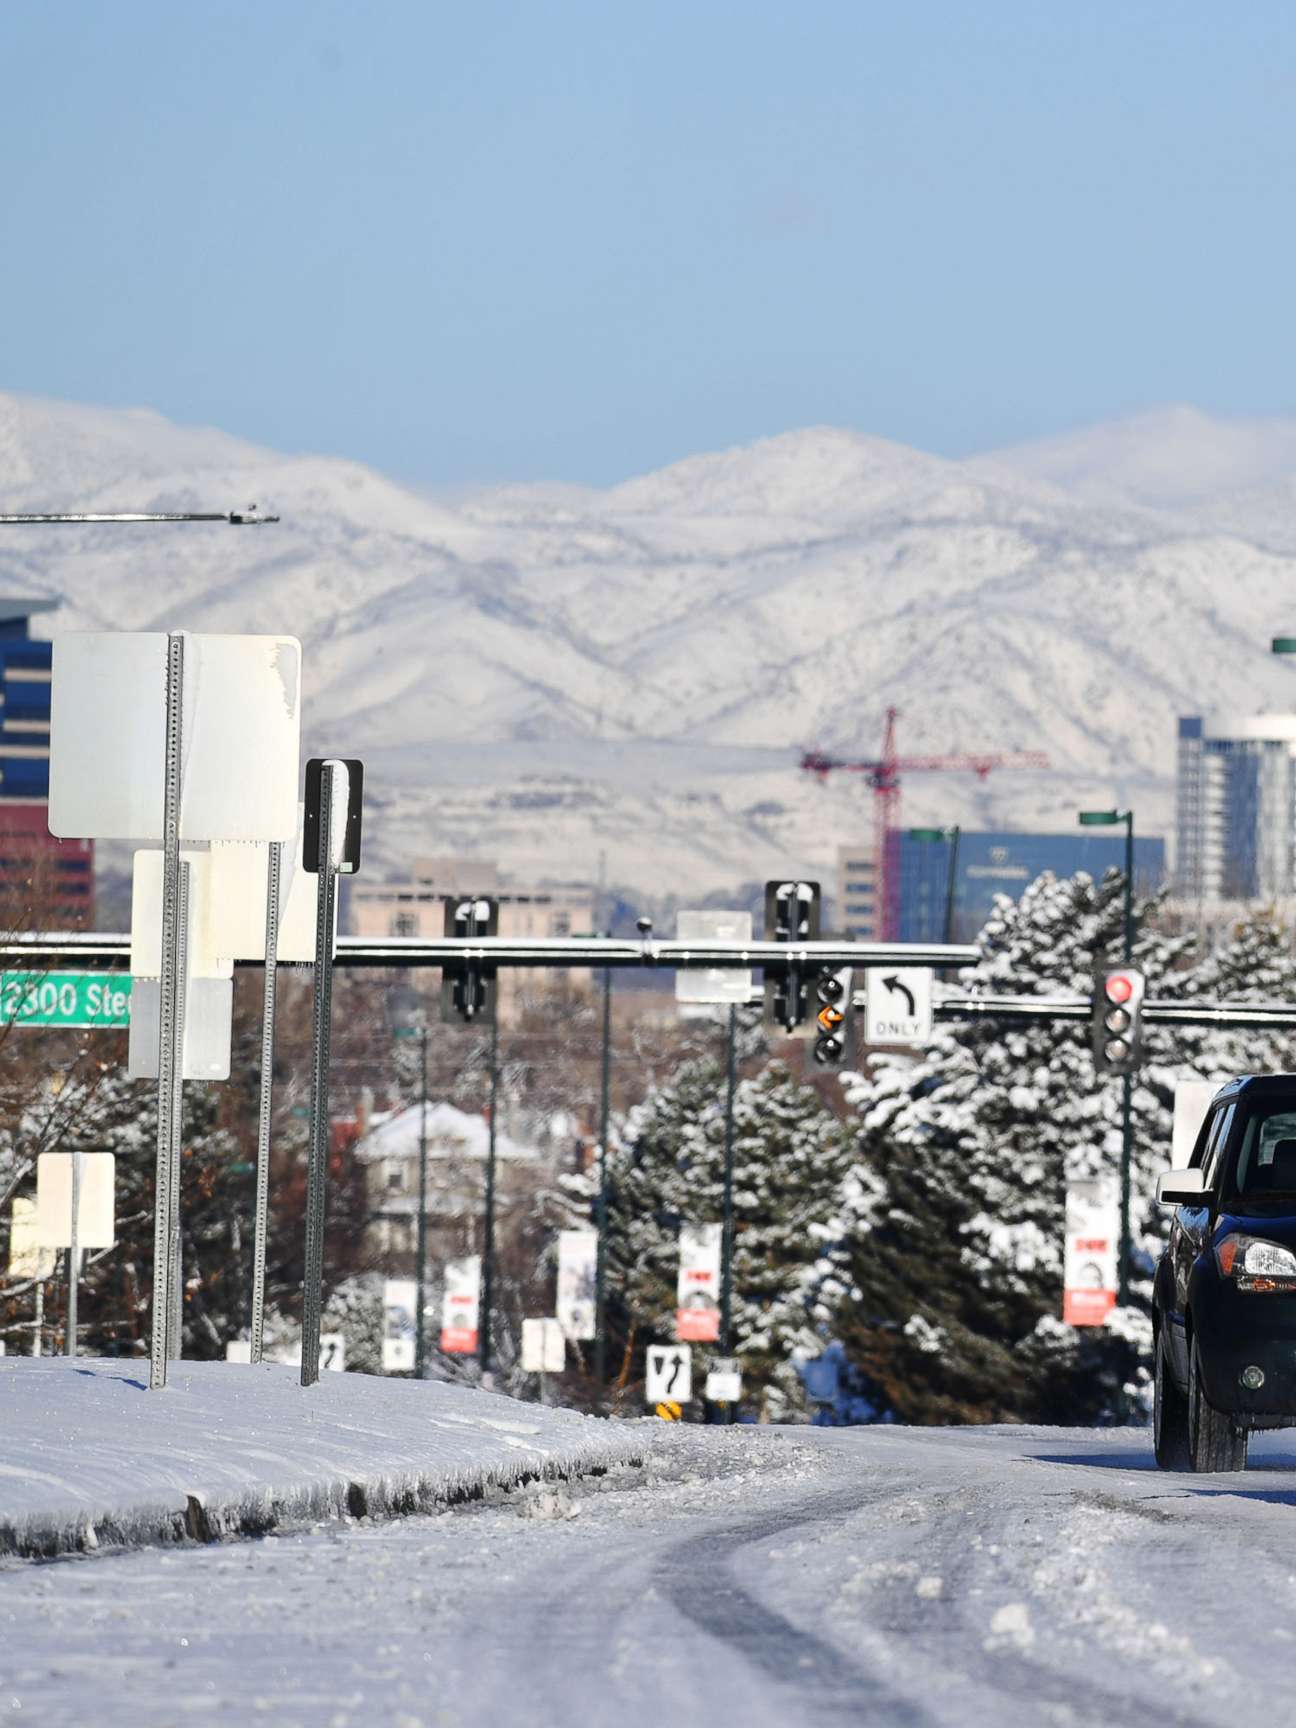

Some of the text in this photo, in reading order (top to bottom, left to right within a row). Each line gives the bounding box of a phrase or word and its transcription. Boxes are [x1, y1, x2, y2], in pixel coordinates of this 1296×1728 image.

[4, 982, 132, 1017] 2300 Ste
[876, 1021, 920, 1036] ONLY
